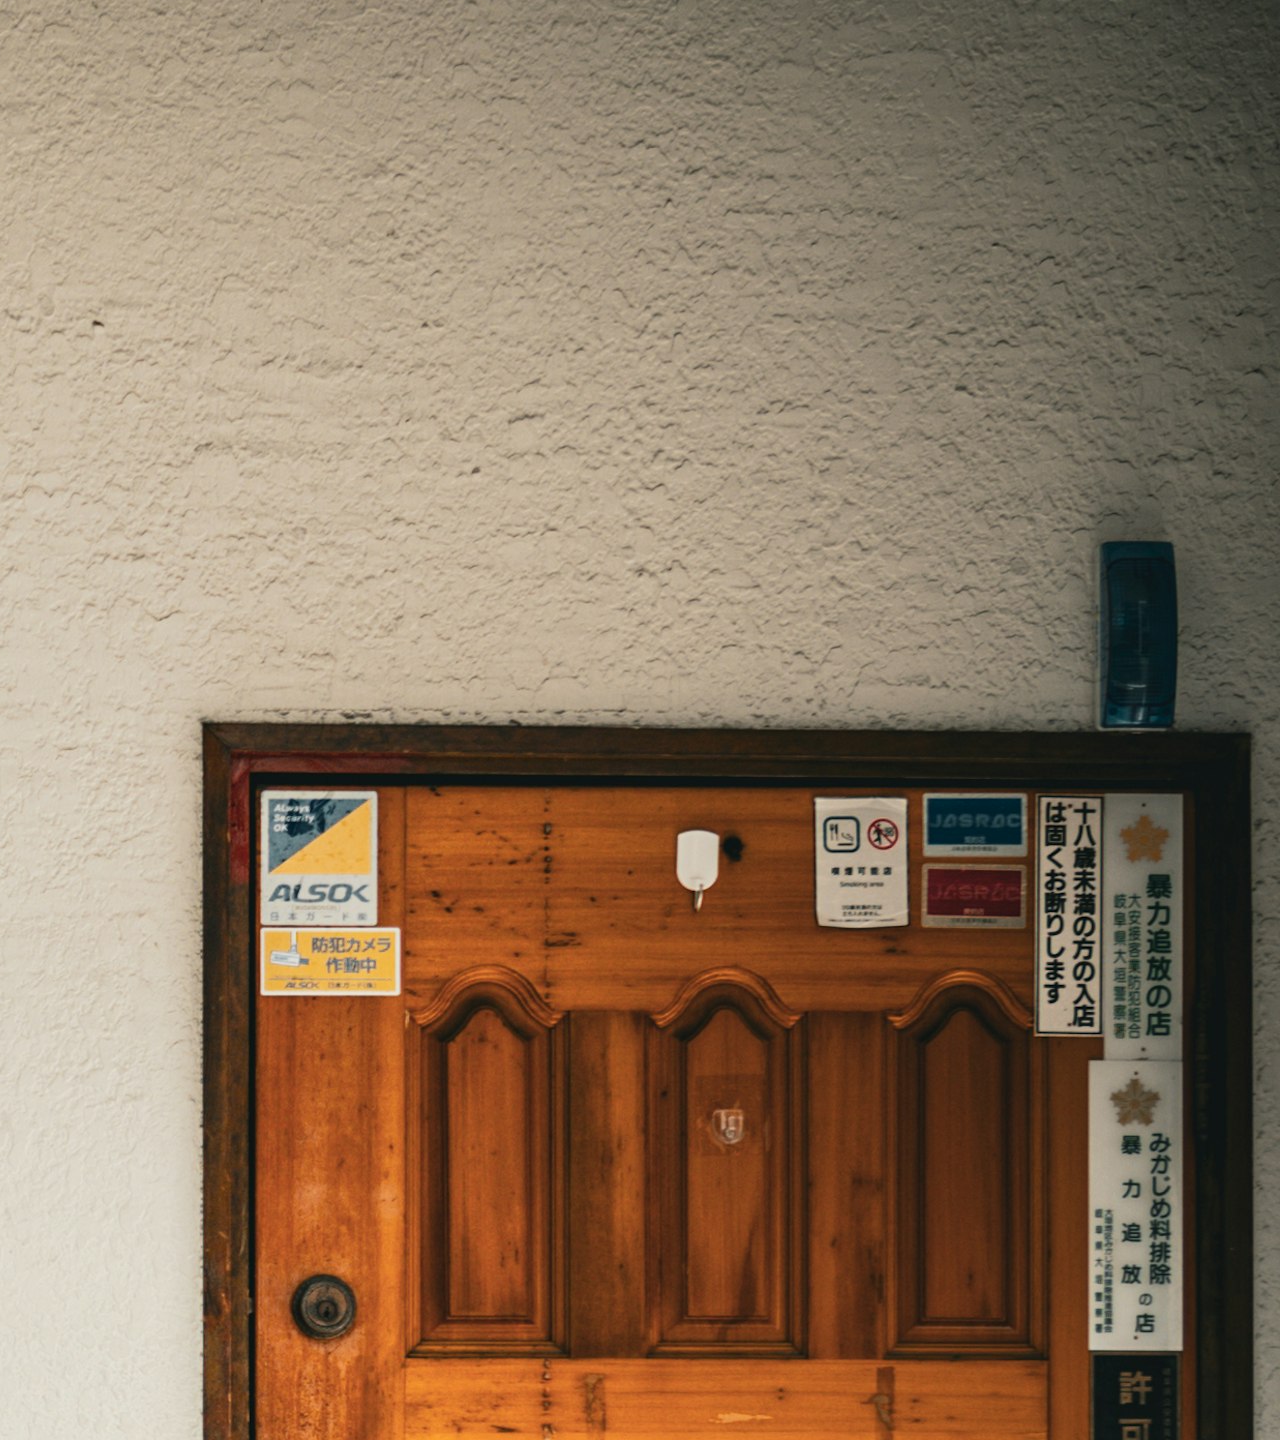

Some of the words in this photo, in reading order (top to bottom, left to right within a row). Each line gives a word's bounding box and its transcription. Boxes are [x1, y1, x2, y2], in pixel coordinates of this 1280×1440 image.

[273, 823, 289, 832] OK
[274, 813, 315, 824] Security
[930, 813, 1021, 829] JASRAC
[268, 883, 370, 903] ALSOK
[929, 882, 1021, 902] JASRAC
[1044, 801, 1067, 1005] は固くお断りします
[1072, 801, 1097, 1029] 十八歳未満の方の入店
[311, 937, 392, 954] 防犯カメラ
[1146, 873, 1172, 1037] 暴力追放の店
[326, 957, 377, 974] 作動中
[284, 981, 320, 990] ALSOK
[1149, 1133, 1172, 1286] みかじめ料排除
